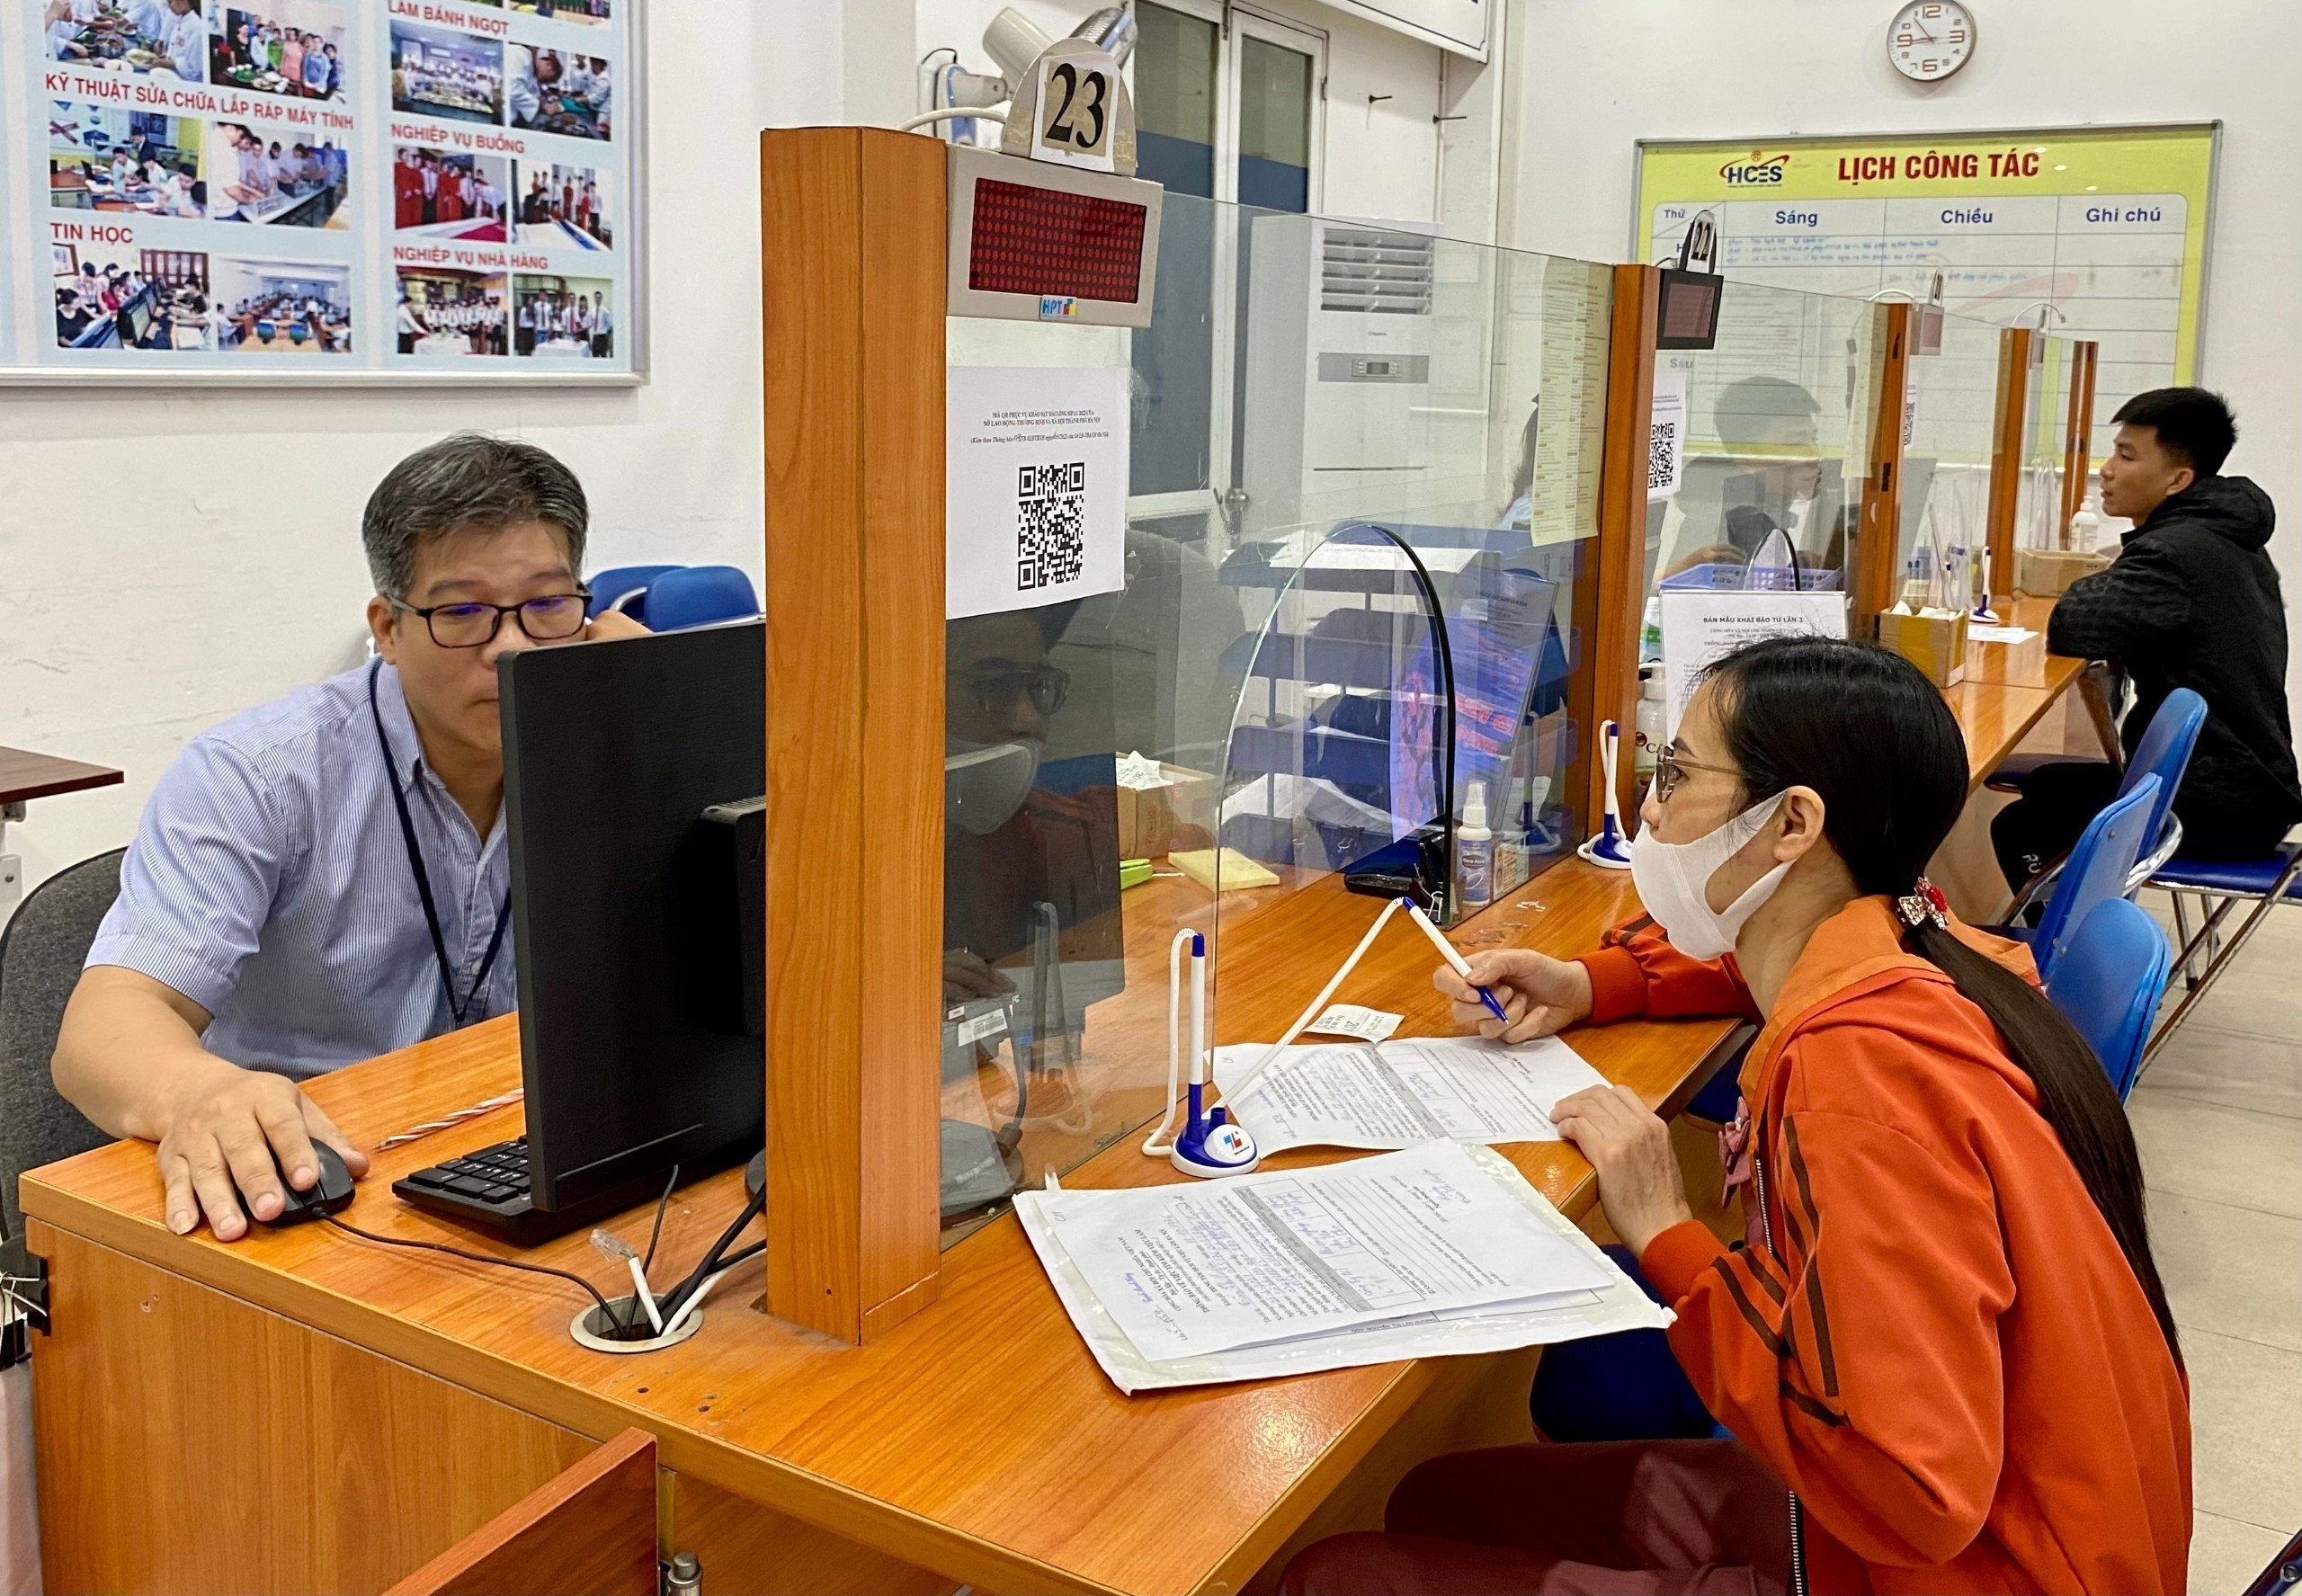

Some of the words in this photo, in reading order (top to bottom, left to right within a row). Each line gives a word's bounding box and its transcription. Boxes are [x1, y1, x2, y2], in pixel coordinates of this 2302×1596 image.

[424, 5, 464, 27] BÁNH
[468, 15, 511, 35] NGỌT
[1923, 4, 1941, 19] 12
[1896, 33, 1912, 48] 9
[1950, 30, 1965, 43] 3
[1923, 58, 1938, 72] 6
[45, 72, 69, 92] KỸ
[75, 77, 130, 103] THUẬT
[135, 82, 169, 106] SỬA
[173, 90, 216, 112] CHỮA
[287, 105, 317, 125] MÁY
[321, 110, 354, 130] TÍNH
[1045, 62, 1106, 148] 23
[391, 123, 448, 145] NGHIỆP
[452, 131, 472, 149] VỤ
[1727, 165, 1782, 183] HCES
[1837, 156, 1896, 185] LỊCH
[1905, 149, 1978, 179] CÔNG
[1987, 147, 2039, 177] TÁC
[1664, 209, 1686, 218] Thứ
[1775, 210, 1818, 227] Sáng
[1941, 208, 1994, 224] Chiều
[2086, 208, 2119, 222] Ghi
[2125, 206, 2161, 222] chú
[50, 222, 83, 240] TIN
[90, 226, 134, 245] HỌC
[1691, 221, 1711, 261] 22
[393, 245, 451, 263] NGHIỆP
[455, 250, 474, 265] VỤ
[477, 250, 507, 267] NHÀ
[511, 253, 549, 270] HÀNG
[1042, 299, 1063, 315] HPT
